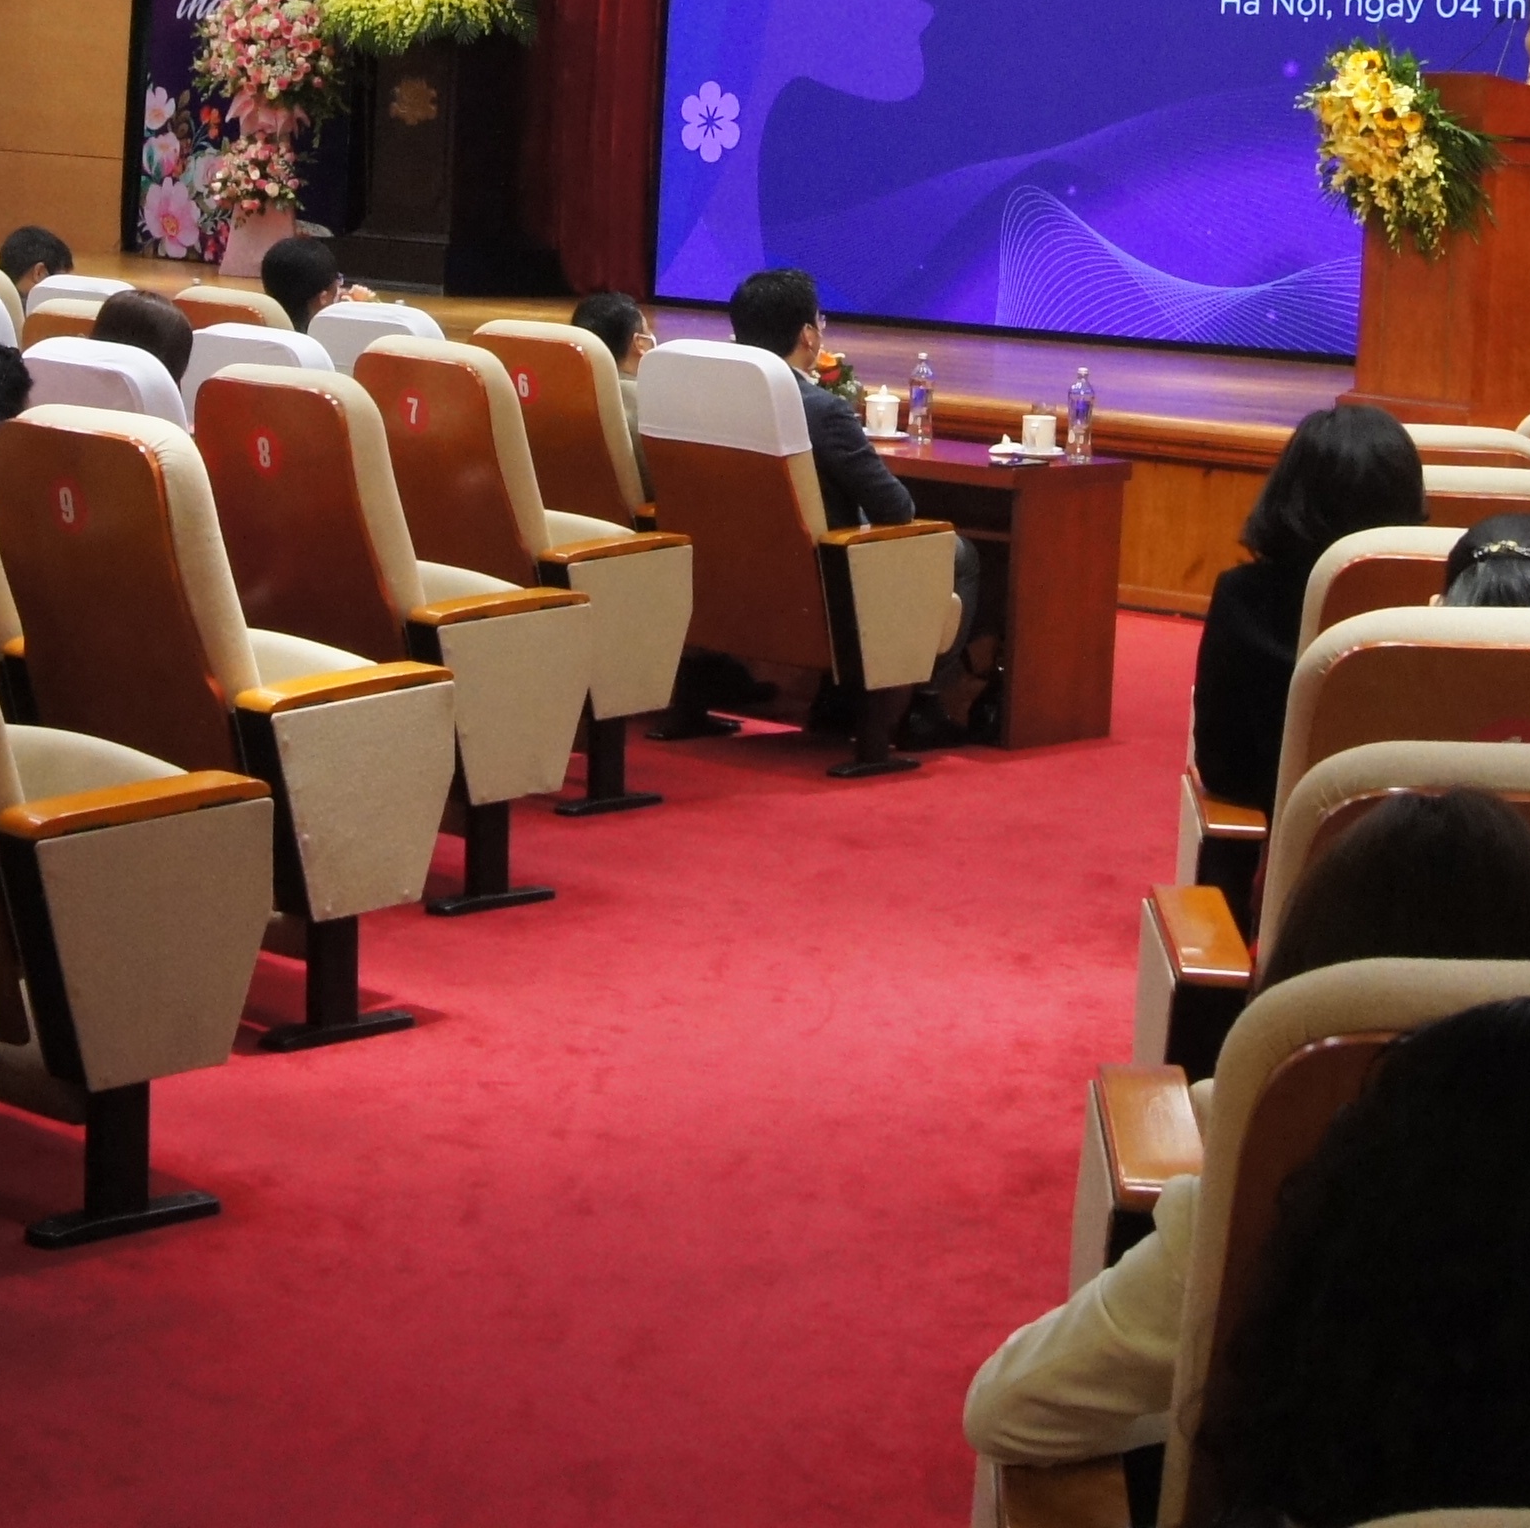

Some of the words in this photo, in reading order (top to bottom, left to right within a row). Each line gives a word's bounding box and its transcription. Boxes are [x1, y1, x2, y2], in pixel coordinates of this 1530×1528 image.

[517, 373, 530, 398] 6
[406, 397, 419, 424] 7
[257, 436, 271, 468] 8
[59, 486, 75, 523] 9
